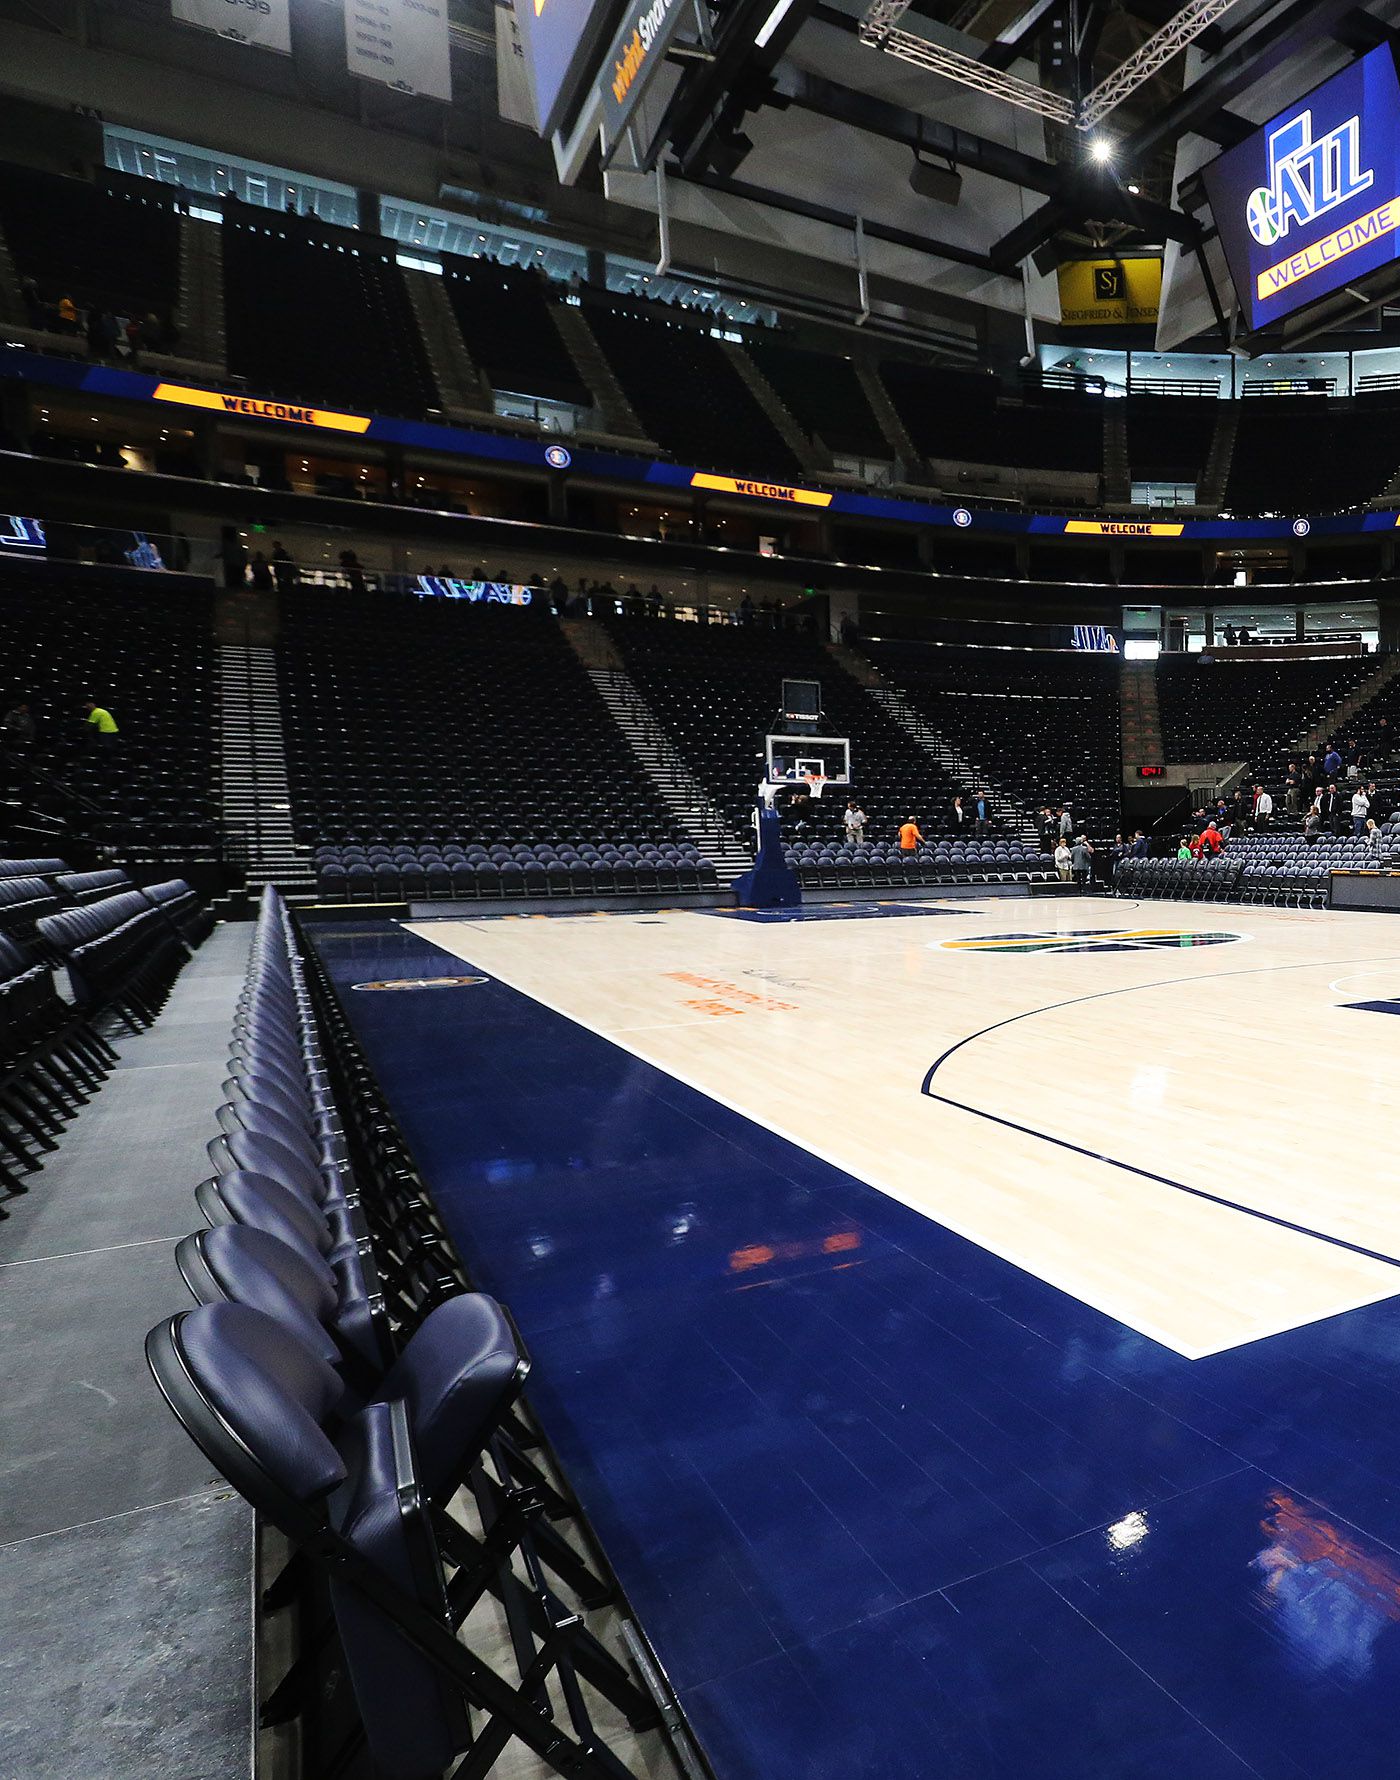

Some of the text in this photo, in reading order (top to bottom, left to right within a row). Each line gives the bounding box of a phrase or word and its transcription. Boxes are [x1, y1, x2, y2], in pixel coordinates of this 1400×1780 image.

[1246, 109, 1374, 246] JAZZ
[1268, 206, 1394, 288] WELCOME
[221, 396, 314, 424] WELCOME
[735, 480, 795, 500] WELCOME
[1100, 523, 1151, 534] WELCOME
